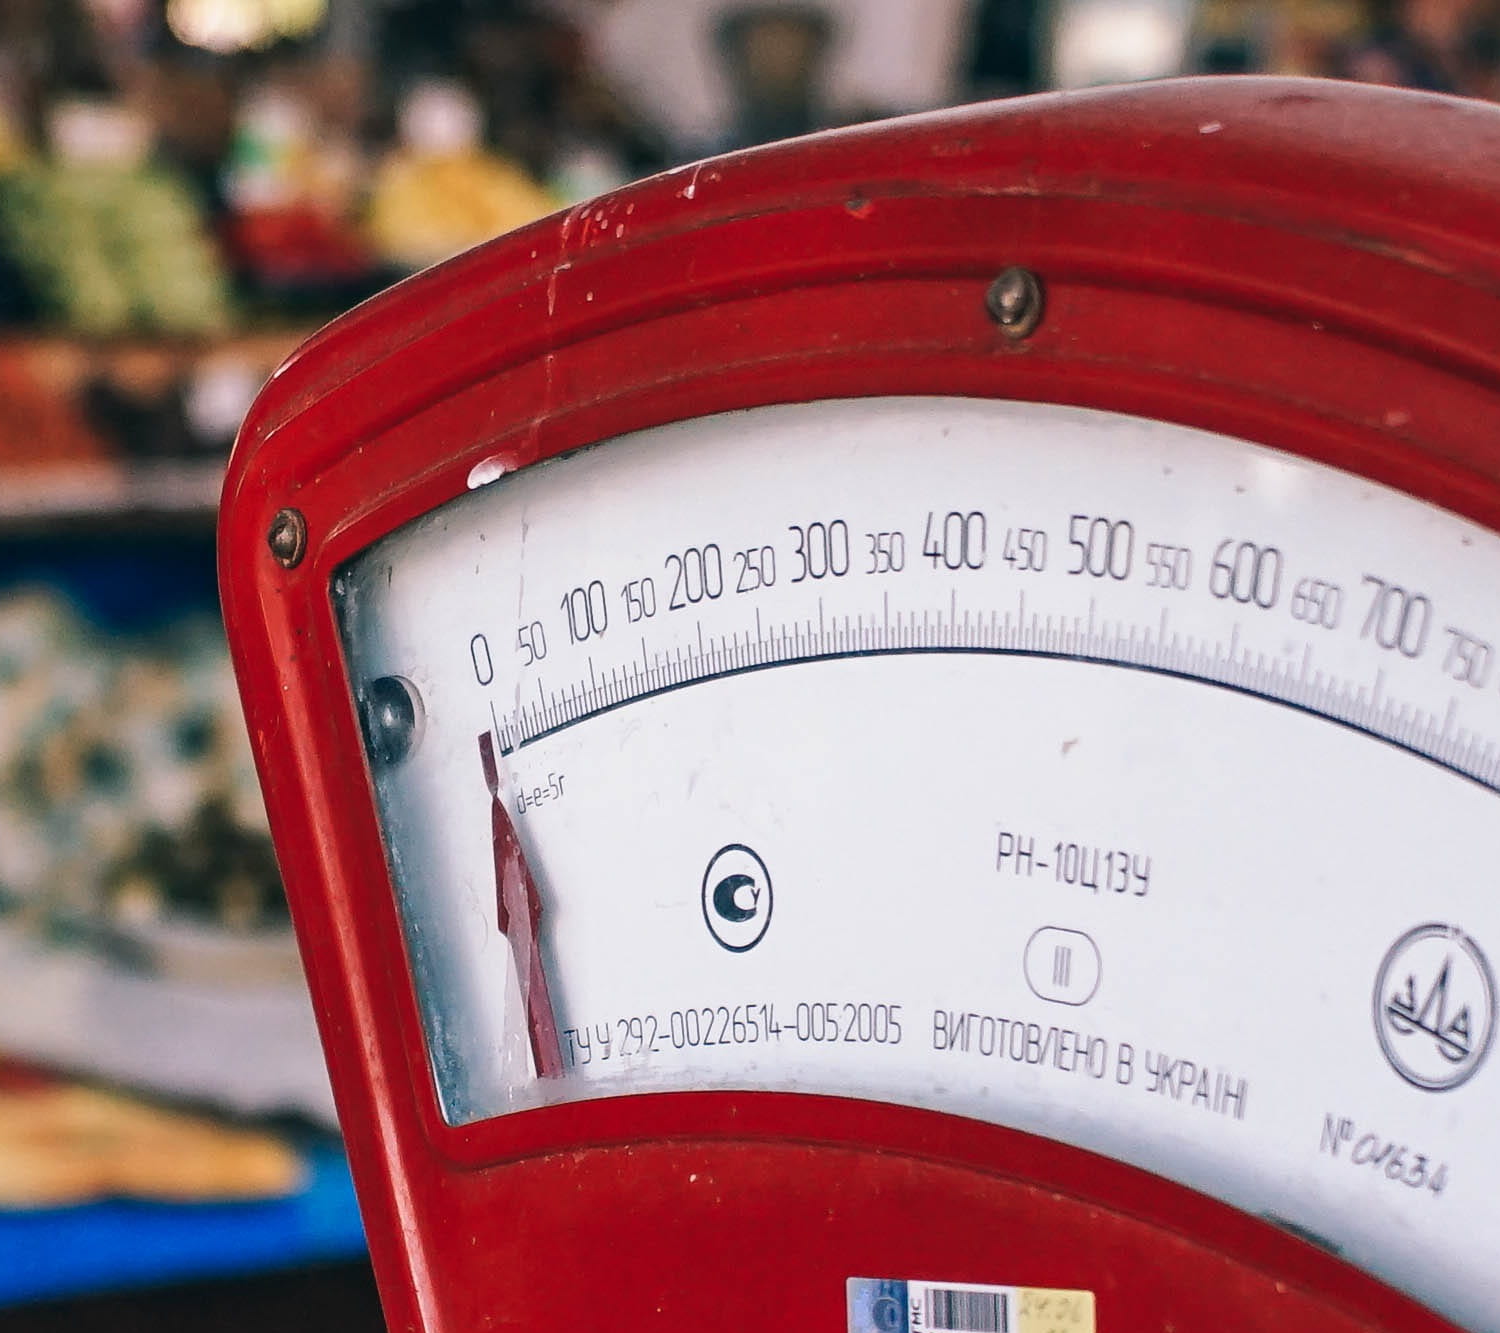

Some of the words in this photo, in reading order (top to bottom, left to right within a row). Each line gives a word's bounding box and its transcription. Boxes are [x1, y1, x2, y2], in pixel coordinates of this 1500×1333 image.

[470, 633, 494, 686] 0
[517, 621, 547, 667] 50
[560, 580, 608, 645] 100
[620, 577, 657, 623] 150
[664, 543, 724, 611] 200
[732, 545, 776, 594] 250
[788, 519, 850, 583] 300
[864, 531, 905, 574] 350
[922, 511, 987, 570] 400
[1002, 527, 1048, 572] 450
[1067, 514, 1135, 580] 500
[1145, 542, 1193, 591] 550
[1208, 538, 1285, 610] 600
[1290, 577, 1344, 630] 650
[1360, 571, 1434, 659] 700
[1442, 625, 1495, 690] 750
[563, 1026, 591, 1067] ТУ
[932, 1009, 1109, 1079] ВИГОТОВЛЕНО
[1116, 1042, 1135, 1086] В
